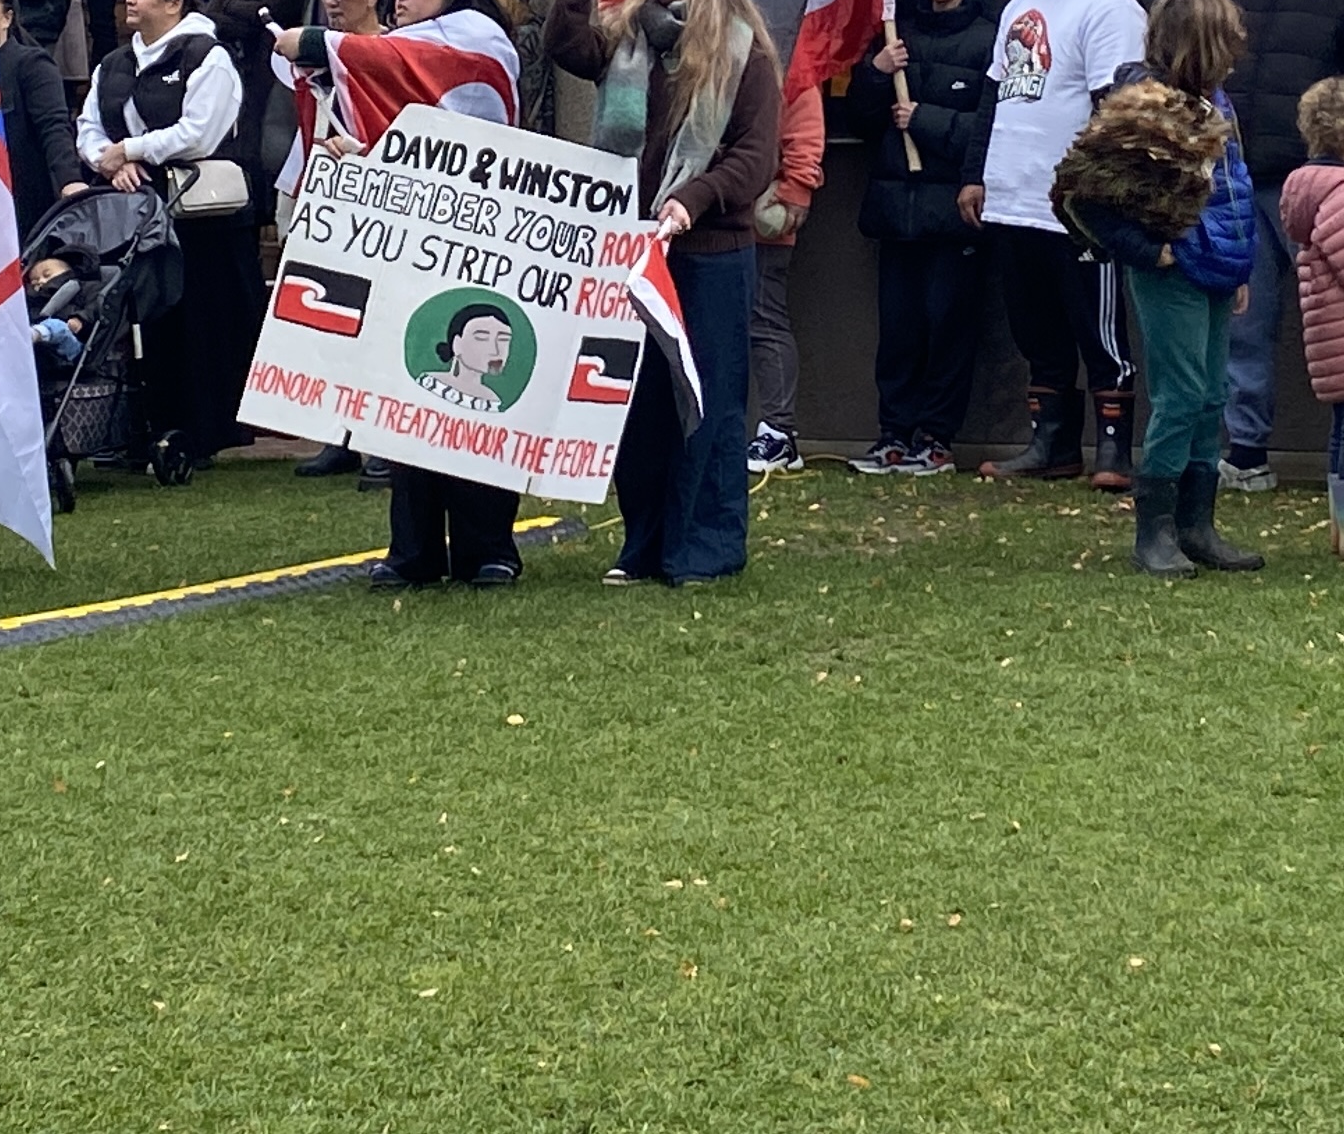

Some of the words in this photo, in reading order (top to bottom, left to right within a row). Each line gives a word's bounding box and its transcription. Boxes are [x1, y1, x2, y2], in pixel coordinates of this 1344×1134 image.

[304, 154, 501, 237] REMEMBER
[505, 206, 597, 268] YOUR
[381, 129, 467, 176] DAVID
[469, 148, 497, 189] &
[499, 157, 633, 216] WINSTON
[288, 202, 335, 243] AS
[343, 213, 408, 262] YOU
[412, 234, 513, 287] STRIP
[517, 265, 573, 311] OUR
[250, 361, 327, 408] HONOUR
[333, 383, 373, 422] THE
[440, 415, 508, 463] HONOUR
[511, 429, 553, 475] THE
[553, 438, 615, 478] PEOPLE
